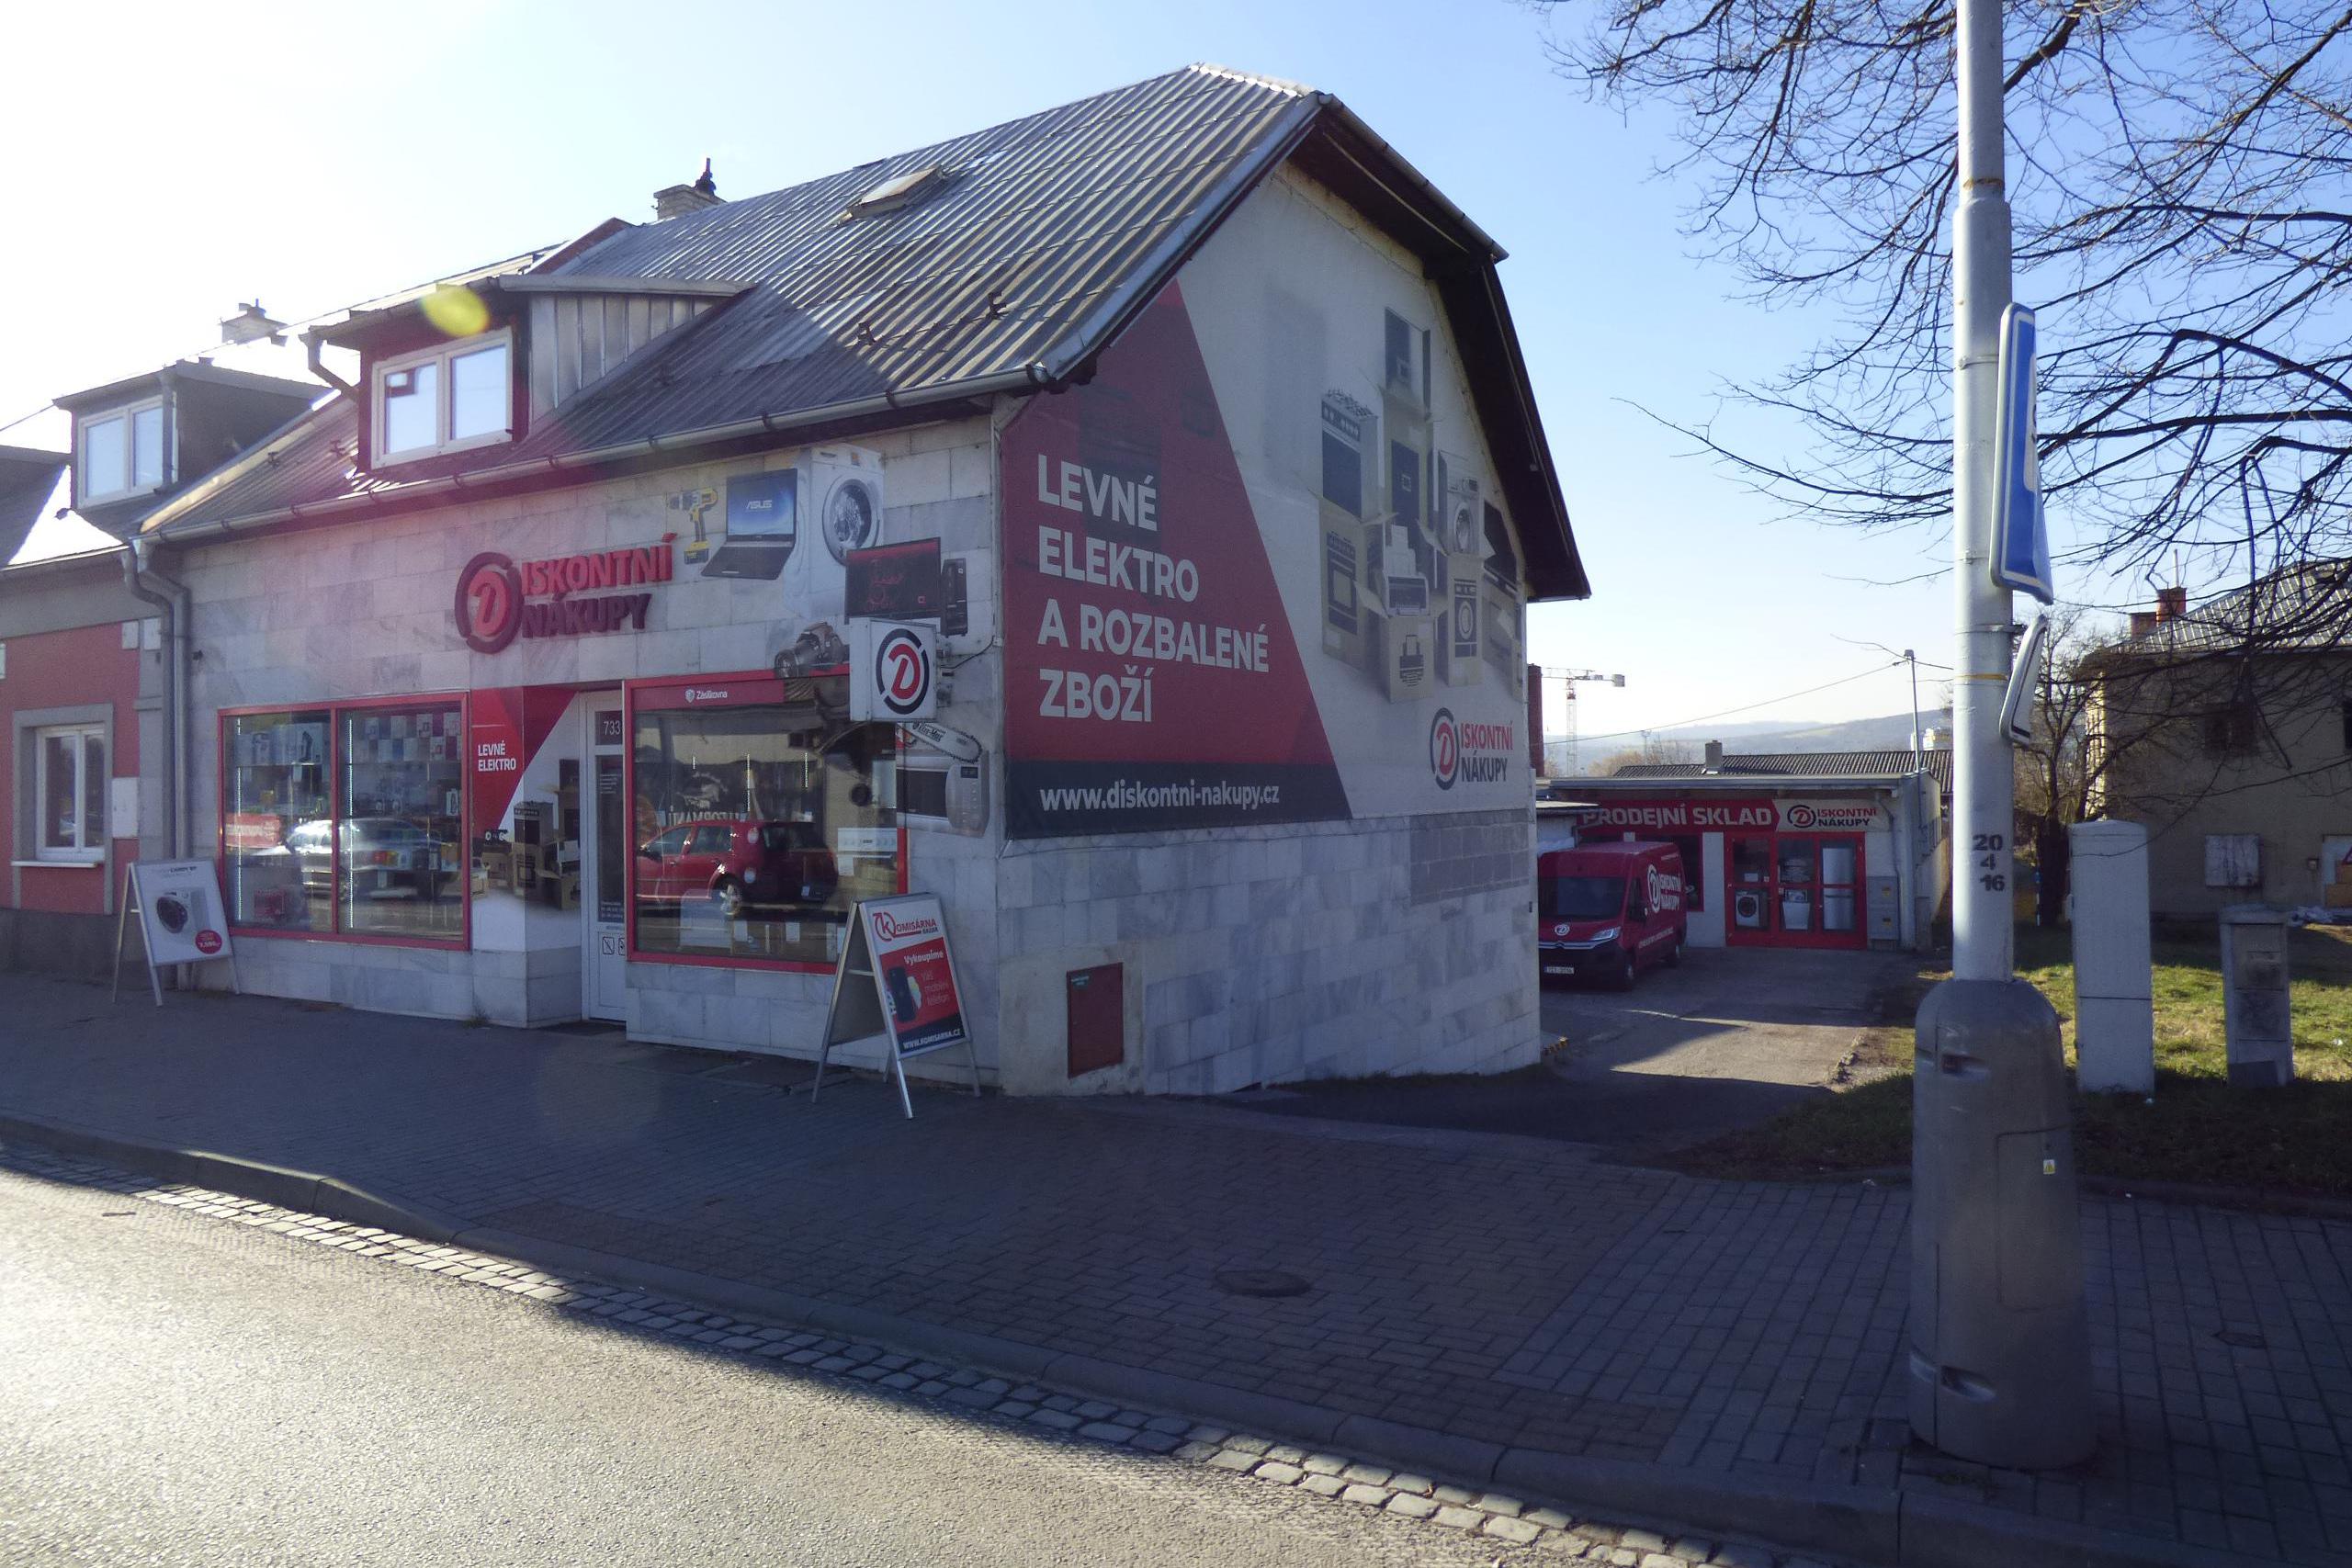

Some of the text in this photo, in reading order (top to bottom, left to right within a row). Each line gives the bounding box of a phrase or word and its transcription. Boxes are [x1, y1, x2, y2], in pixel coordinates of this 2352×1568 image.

[1038, 454, 1158, 531] LEVNÉ
[746, 499, 773, 510] ASUS
[1038, 525, 1199, 602] ELEKTRO
[521, 592, 652, 638] NÁKUPY
[1037, 598, 1269, 672] A ROZBALENÉ
[1039, 664, 1154, 723] ZBOŽÍ
[603, 720, 621, 736] 733
[477, 739, 506, 757] LEVNÉ
[477, 758, 516, 773] ELEKTRO
[1461, 749, 1509, 783] NÁKUPY
[1039, 779, 1280, 811] www.diskontni-nakupy.cz
[1583, 802, 1772, 829] PRODEJNÍ SKLAD
[1817, 818, 1871, 827] NÁKUPY
[1973, 834, 2003, 851] 20
[1980, 854, 1996, 870] 4
[1980, 874, 2005, 891] 16
